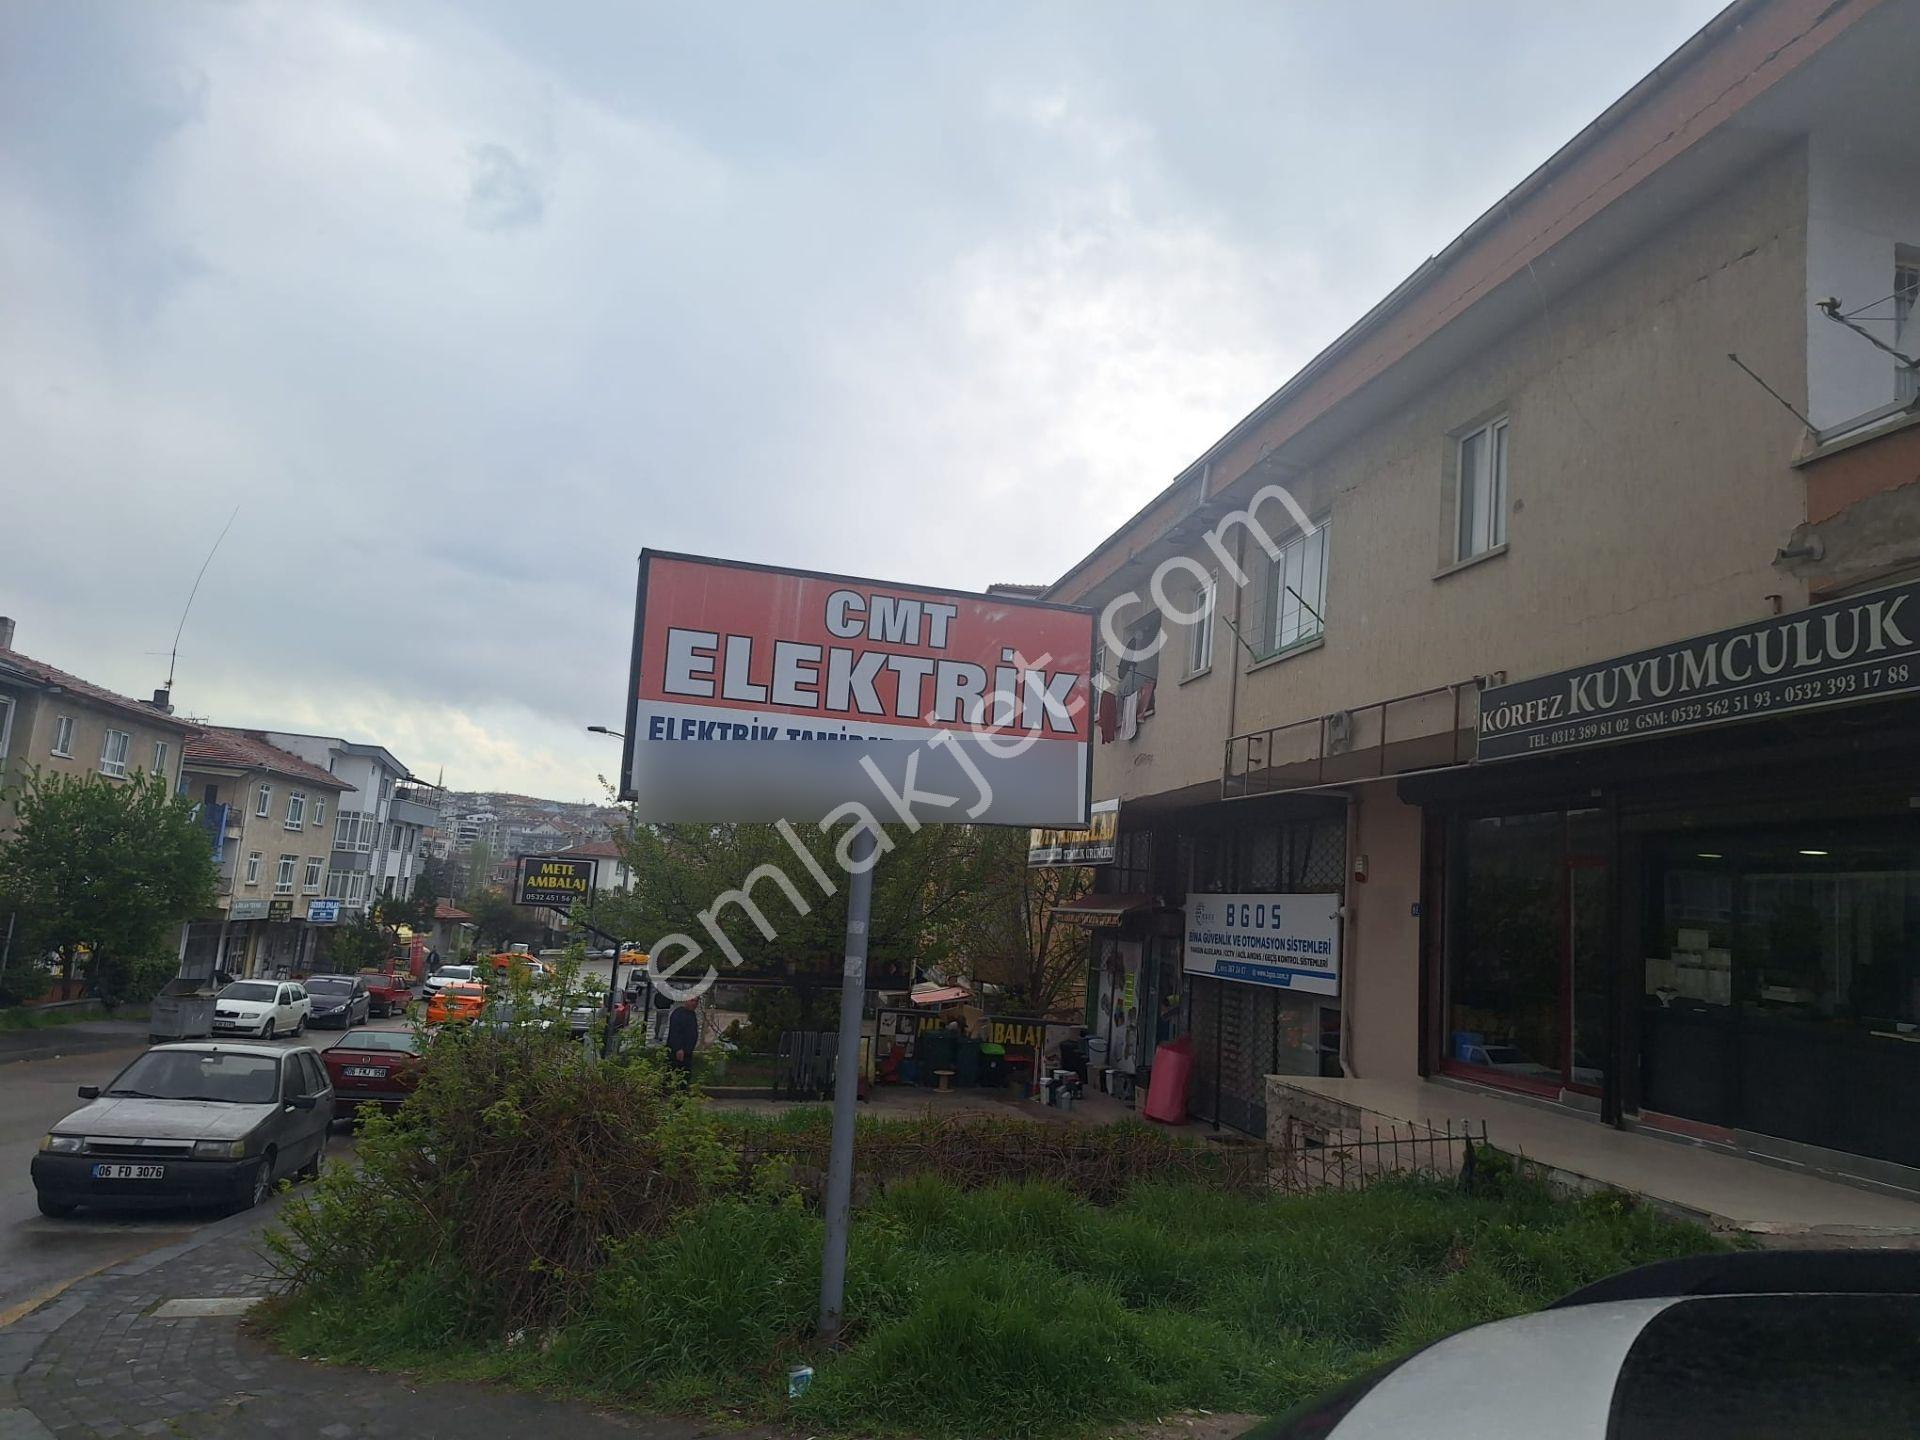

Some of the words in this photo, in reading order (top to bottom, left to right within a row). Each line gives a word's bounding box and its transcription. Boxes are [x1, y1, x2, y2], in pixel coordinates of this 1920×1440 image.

[824, 588, 958, 650] CMT
[1481, 694, 1564, 733] KÖRFEZ
[1568, 594, 1914, 715] KUYUMCULUK
[662, 626, 1078, 734] ELEKTRİK
[1528, 734, 1549, 748] TEL:
[1551, 730, 1576, 745] 0312
[1578, 724, 1597, 741] 389
[1599, 721, 1613, 736] 81
[1615, 718, 1630, 733] 02
[1635, 711, 1669, 730] GSM:
[1671, 702, 1702, 723] 0532
[1706, 698, 1730, 717] 562
[1734, 695, 1749, 712] 51
[1754, 690, 1771, 708] 93
[1784, 680, 1822, 702] 0532
[1827, 674, 1856, 696] 393
[1863, 669, 1882, 689] 17
[1887, 664, 1909, 685] 88
[541, 863, 576, 876] METE
[526, 875, 587, 892] AMBALAJ
[526, 893, 545, 901] 0532
[1189, 929, 1202, 943] BİNA
[1203, 929, 1232, 946] GÜVENLİK
[1232, 933, 1241, 946] VE
[1241, 934, 1286, 951] OTOMASYON
[1287, 935, 1331, 955] SİSTEMLERİ
[98, 1165, 112, 1177] 06
[118, 1166, 132, 1177] FD
[136, 1166, 163, 1178] 3076
